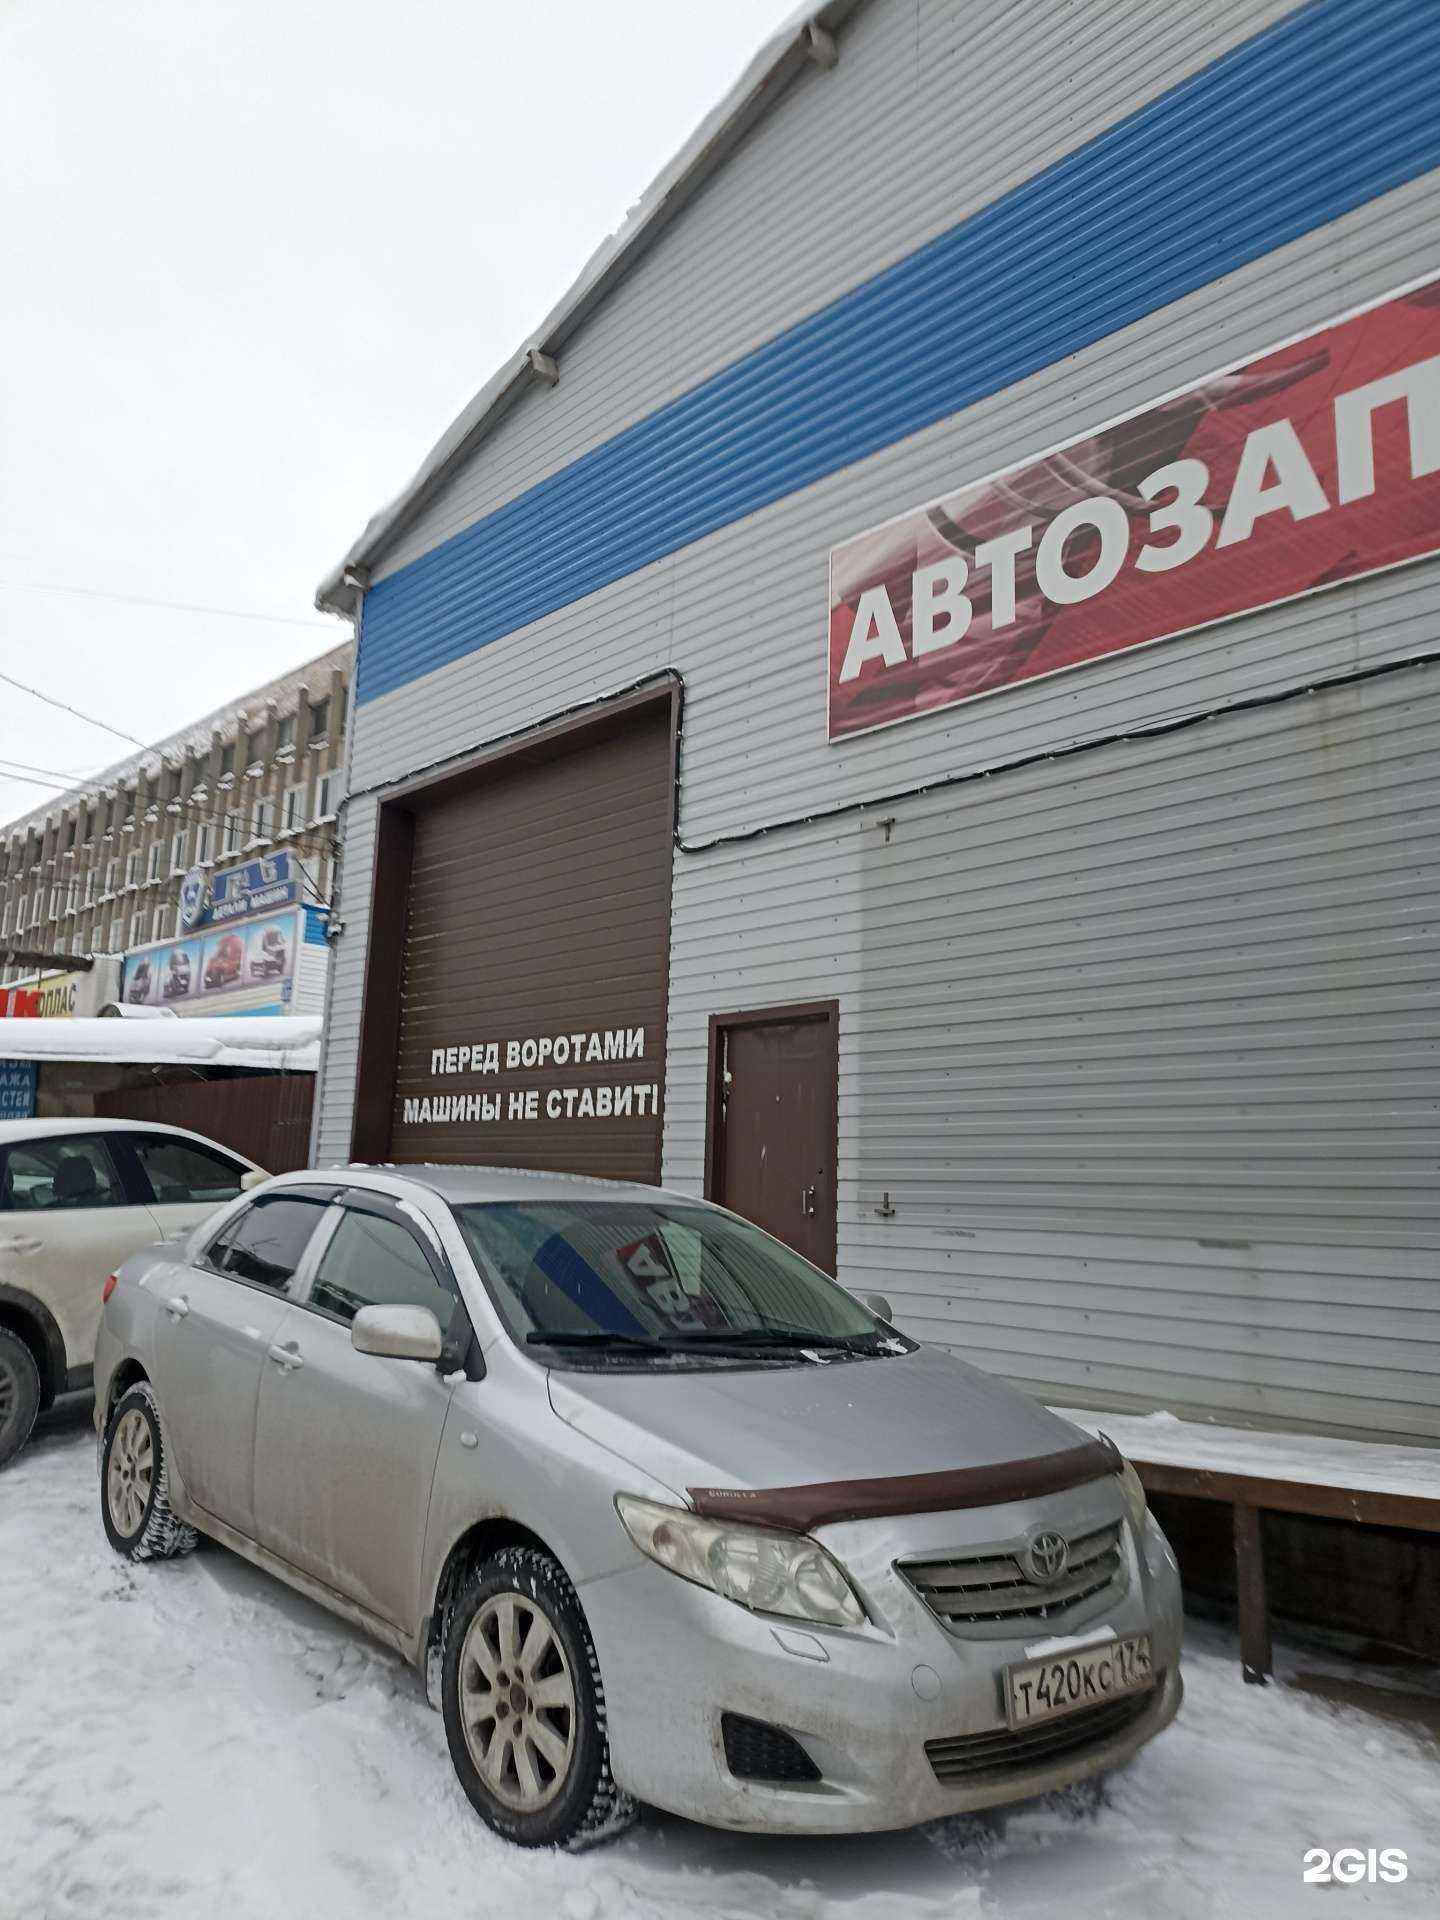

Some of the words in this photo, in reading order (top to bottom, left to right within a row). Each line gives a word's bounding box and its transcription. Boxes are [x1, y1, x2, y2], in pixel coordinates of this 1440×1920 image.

[838, 354, 1440, 684] АВТОЗАП
[431, 1043, 499, 1075] ПЕРЕД
[506, 1027, 645, 1069] ВОРОТАМИ
[403, 1093, 501, 1124] МАШИНЫ
[508, 1091, 539, 1120] НЕ
